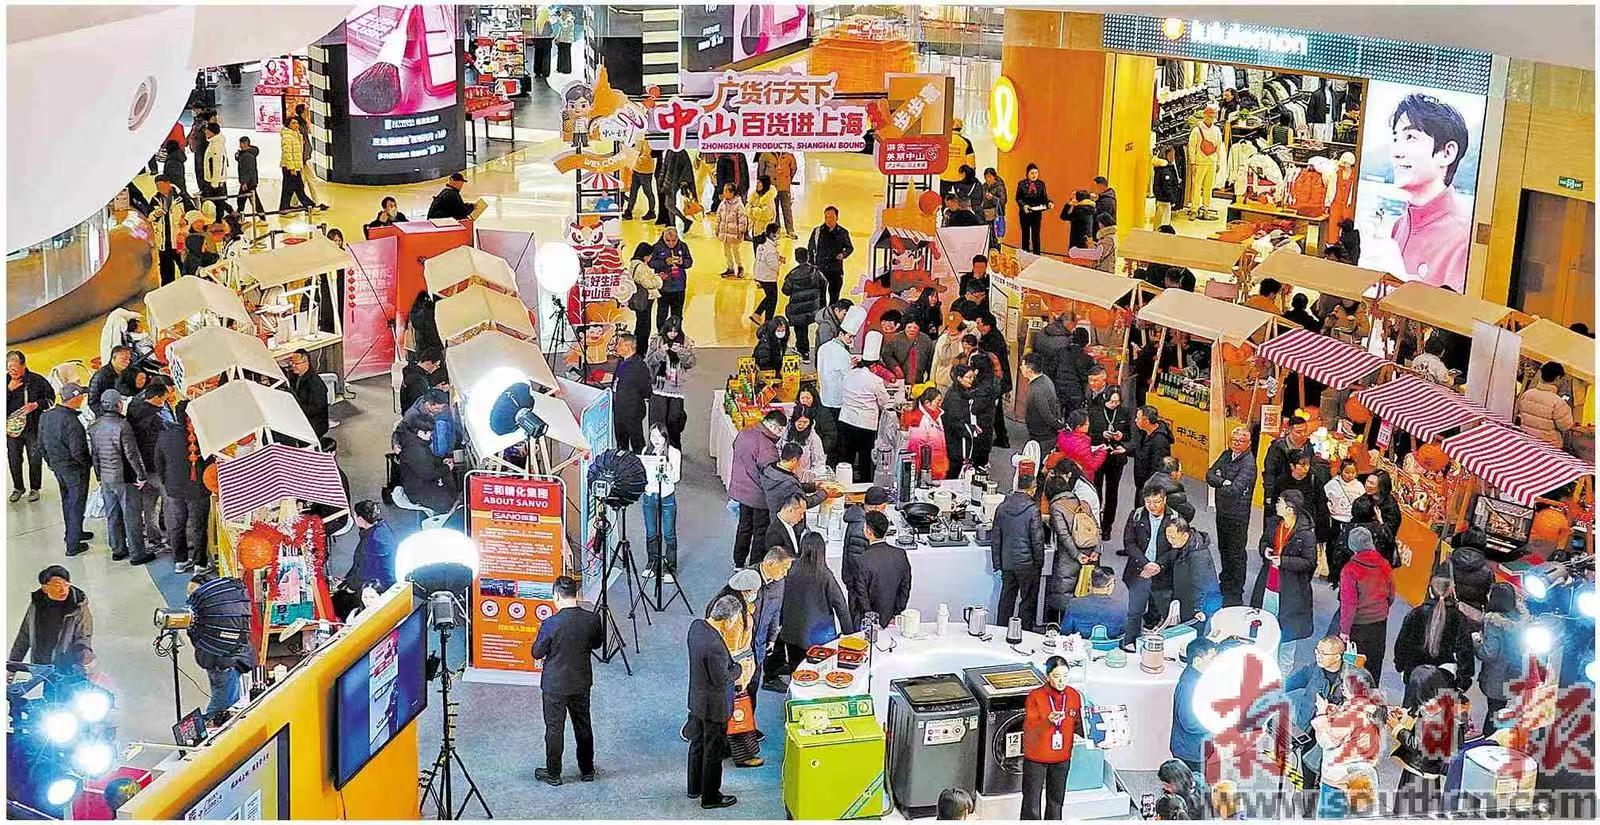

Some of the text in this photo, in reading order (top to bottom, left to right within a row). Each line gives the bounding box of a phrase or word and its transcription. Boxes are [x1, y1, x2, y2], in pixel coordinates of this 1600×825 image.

[702, 75, 833, 113] 广货行天下
[658, 101, 864, 149] 中山百货进上海
[701, 142, 866, 150] ZHONGSHAN PRODUCTS, SHANGHAI BOUND
[482, 496, 549, 509] ABOUT SANVO
[1008, 735, 1019, 744] 12
